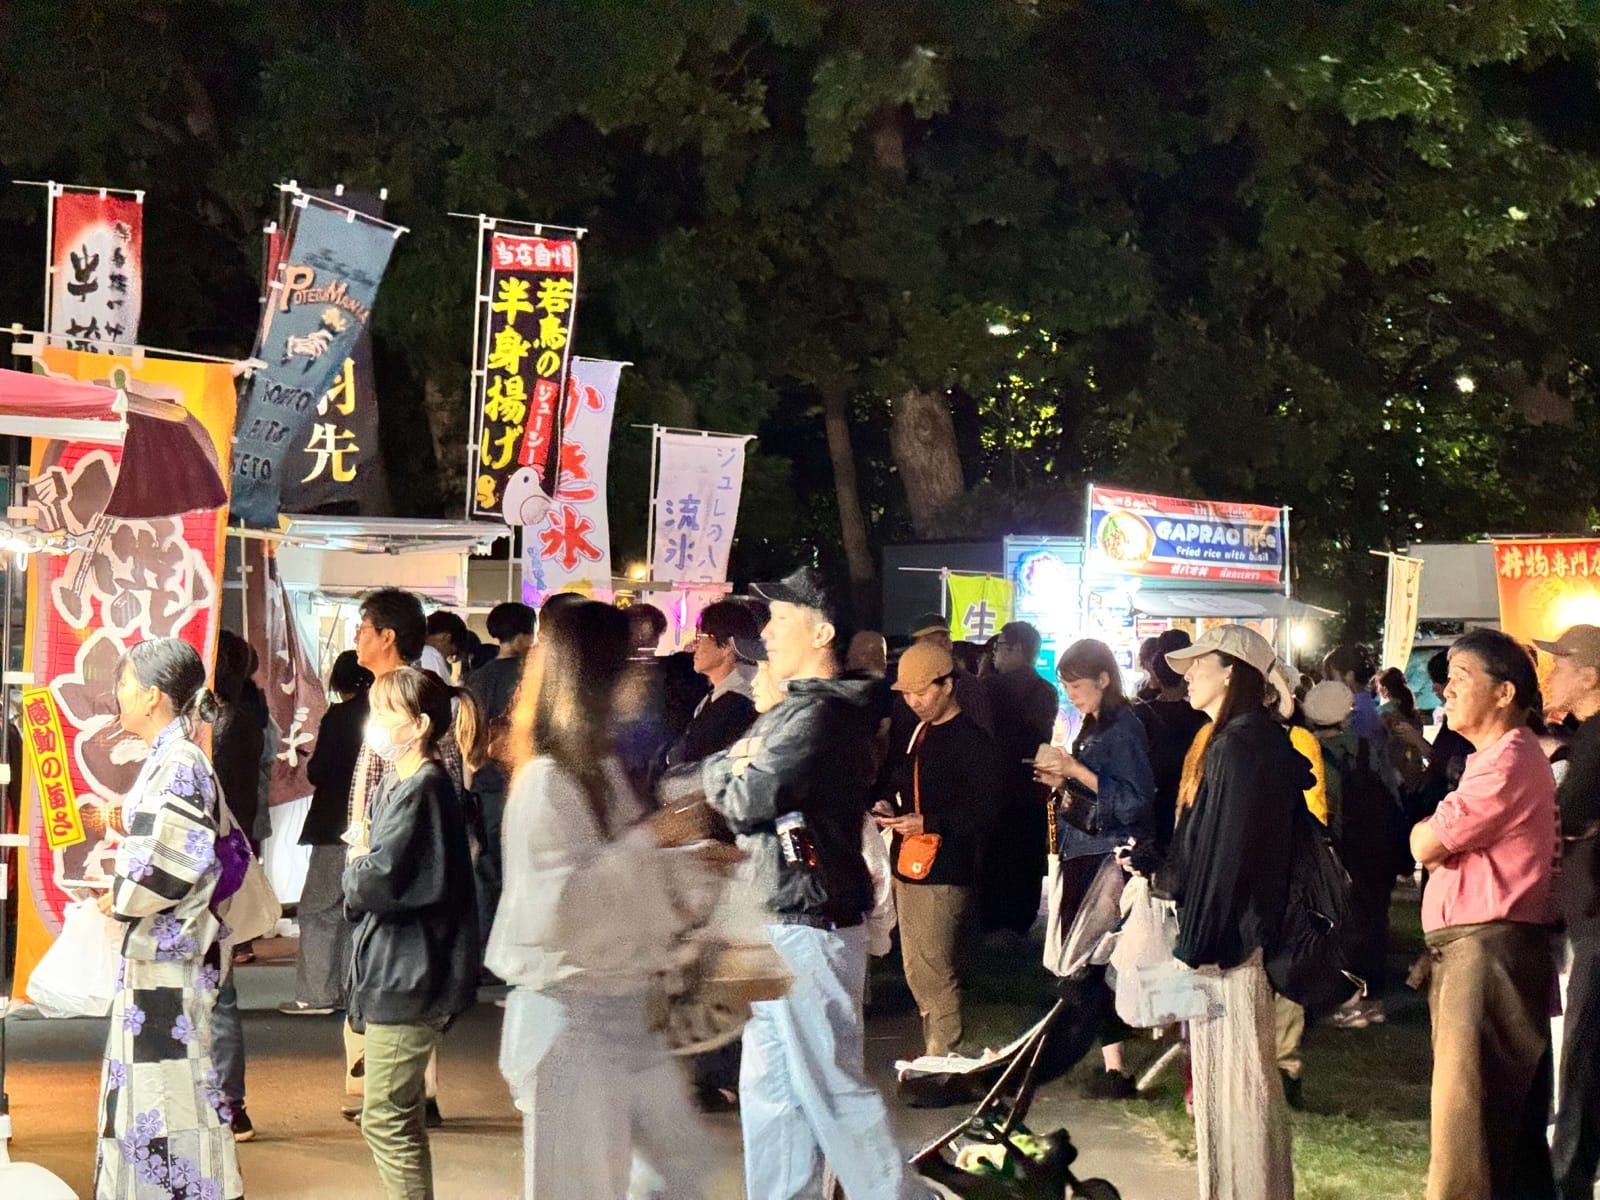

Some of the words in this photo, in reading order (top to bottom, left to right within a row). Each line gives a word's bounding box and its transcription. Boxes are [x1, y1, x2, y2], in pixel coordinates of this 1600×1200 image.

[495, 242, 573, 268] 当店自慢
[533, 277, 573, 378] 若鳥の
[481, 276, 533, 470] 半身揚げ
[527, 384, 553, 464] ジューシー
[664, 493, 701, 581] 流氷
[1176, 546, 1201, 558] Fried
[1204, 548, 1221, 559] rice
[1225, 550, 1246, 560] with
[1249, 551, 1269, 562] basil
[963, 600, 996, 641] 生
